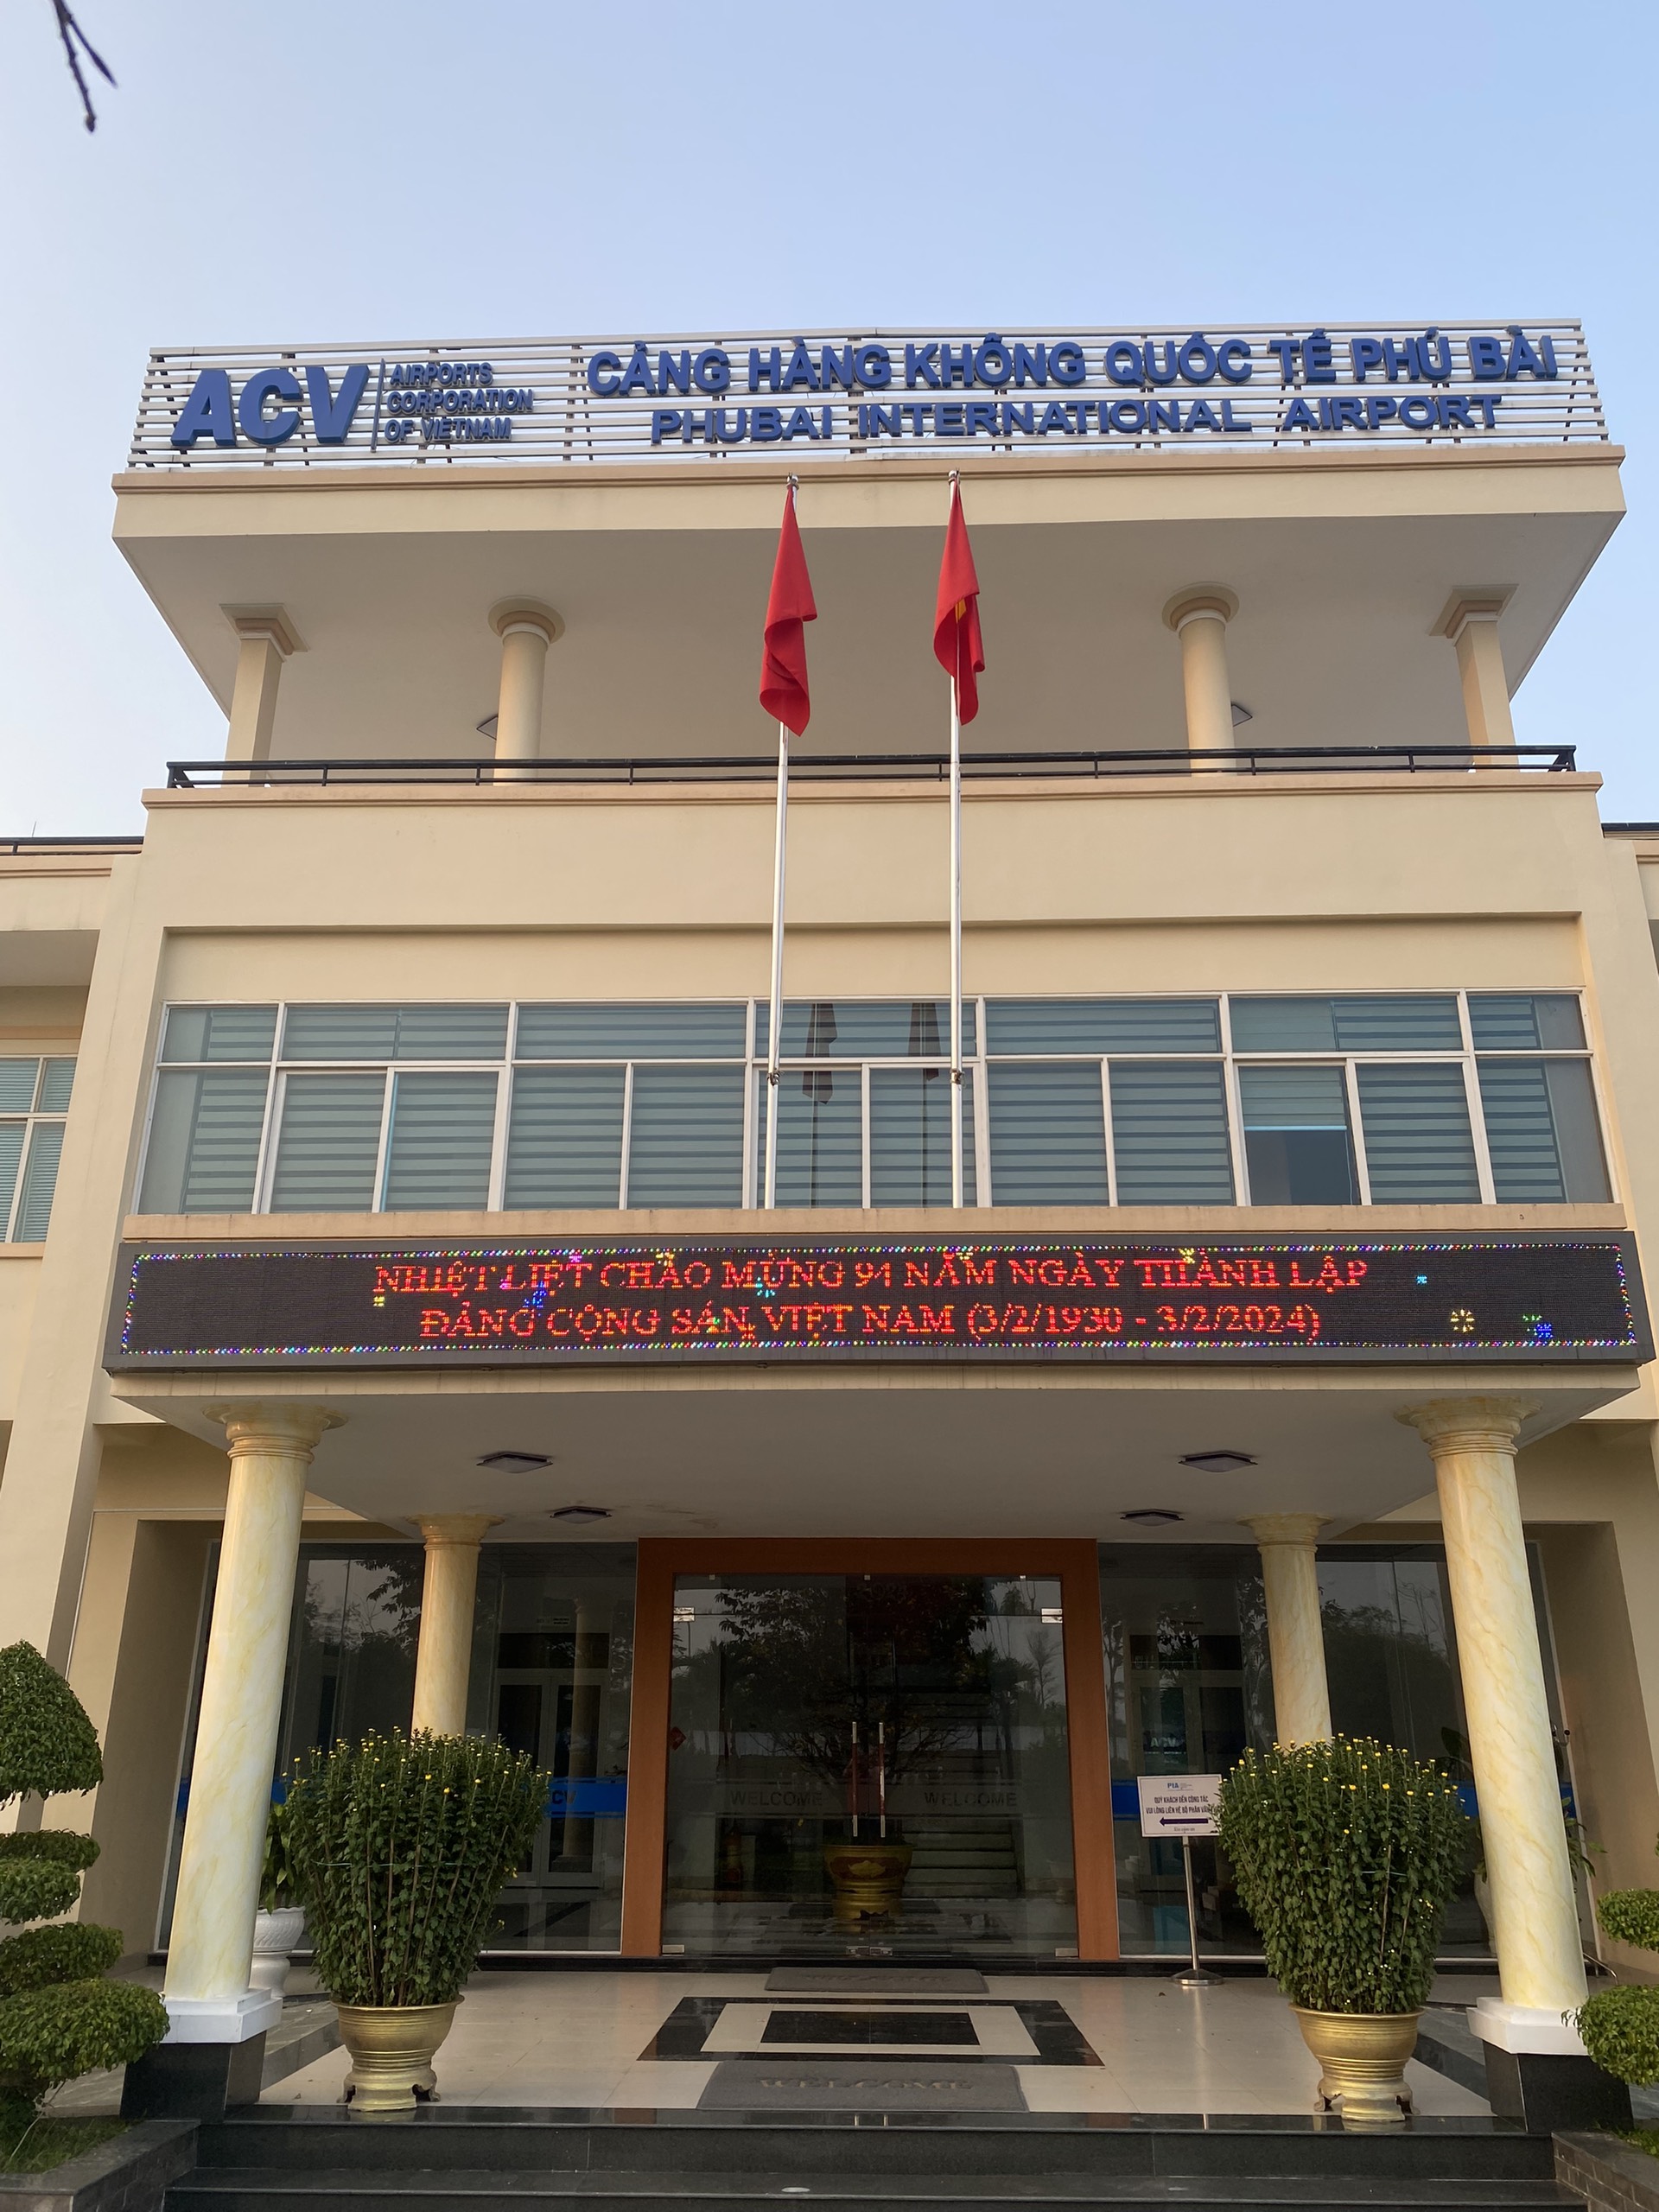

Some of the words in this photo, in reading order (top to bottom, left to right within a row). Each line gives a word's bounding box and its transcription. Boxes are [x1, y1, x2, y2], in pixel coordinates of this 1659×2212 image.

[390, 361, 493, 387] AIRPORTS
[588, 340, 729, 397] CẢNG
[748, 336, 892, 393] HÀNG
[904, 332, 1086, 389] KHÔNG
[1104, 331, 1253, 387] QUỐC
[1267, 327, 1338, 385] TẾ
[1350, 326, 1453, 382] PHÚ
[1466, 324, 1558, 381] BÀI
[169, 365, 371, 448] ACV
[386, 388, 534, 415] CORPORATION
[384, 418, 413, 444] OF
[421, 416, 513, 442] VIETNAM
[651, 404, 832, 447] PHUBAI
[857, 397, 1252, 440] INTERNATIONAL
[1281, 393, 1503, 432] AIRPORT
[1009, 1251, 1125, 1287] NGÀY
[1289, 1255, 1368, 1294] LẬP
[547, 1304, 662, 1342] CỘNG
[862, 1305, 955, 1333] NAM
[730, 1791, 823, 1807] WELCOME
[924, 1791, 1018, 1808] WELCOME
[760, 2078, 974, 2090] WELCOME
